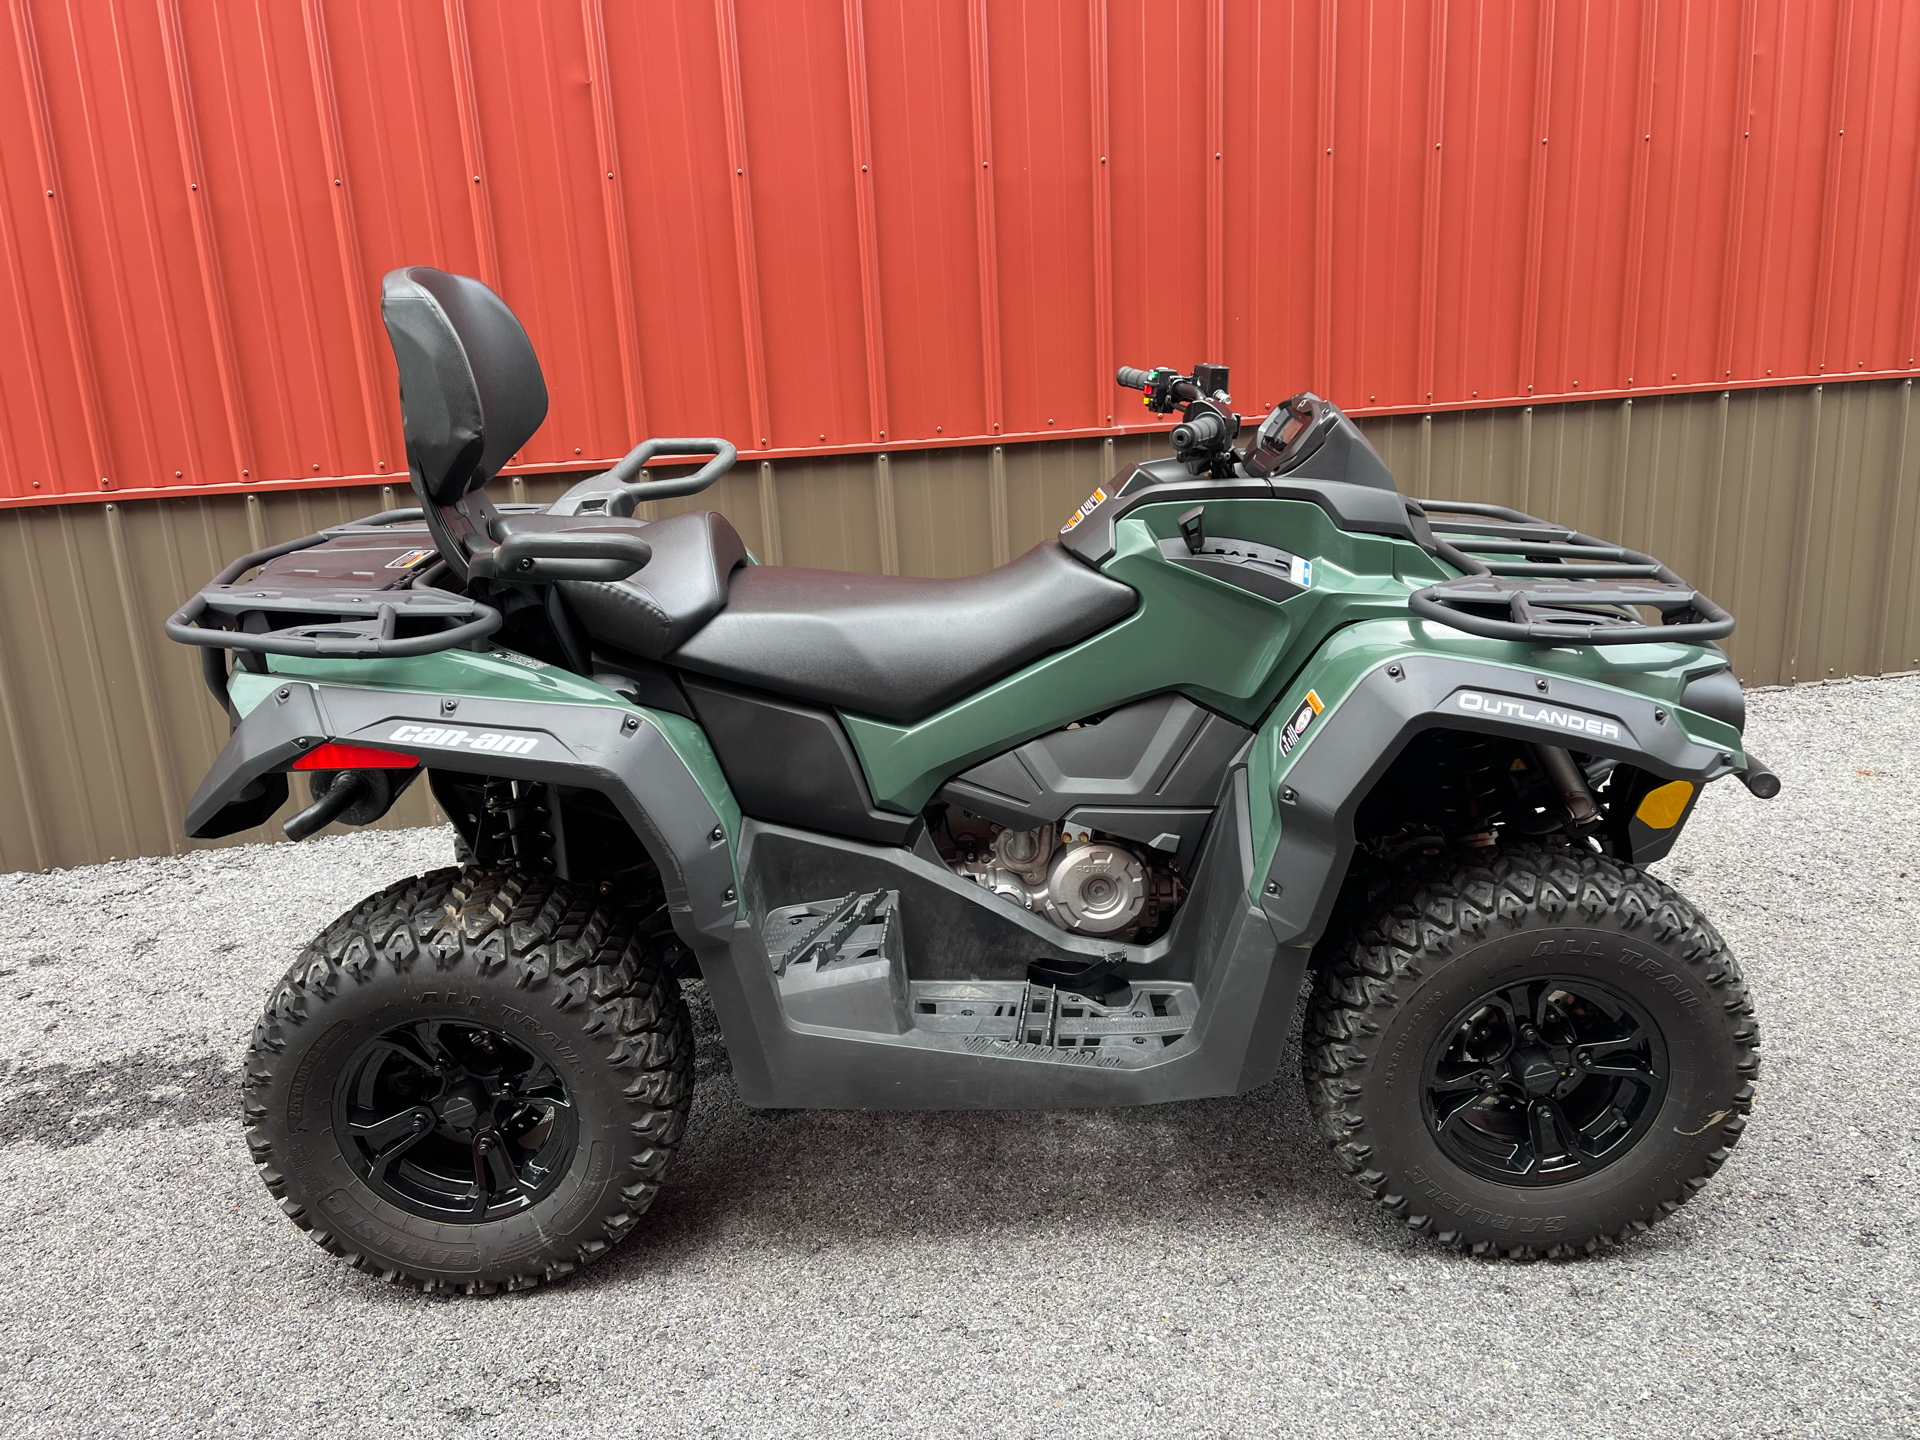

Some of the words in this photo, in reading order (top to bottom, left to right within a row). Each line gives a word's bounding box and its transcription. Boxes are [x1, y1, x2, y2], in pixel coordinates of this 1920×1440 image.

[389, 725, 539, 754] can-am
[1459, 693, 1619, 738] OUTLANDER
[1076, 864, 1112, 874] ROTAX
[1531, 939, 1604, 957] ALL
[1618, 948, 1701, 1016] TRAIL
[418, 991, 486, 1009] ALL
[500, 1004, 582, 1073] TRAIL
[324, 1194, 472, 1266] CARLISLE
[1404, 1165, 1567, 1232] CARLISLE
